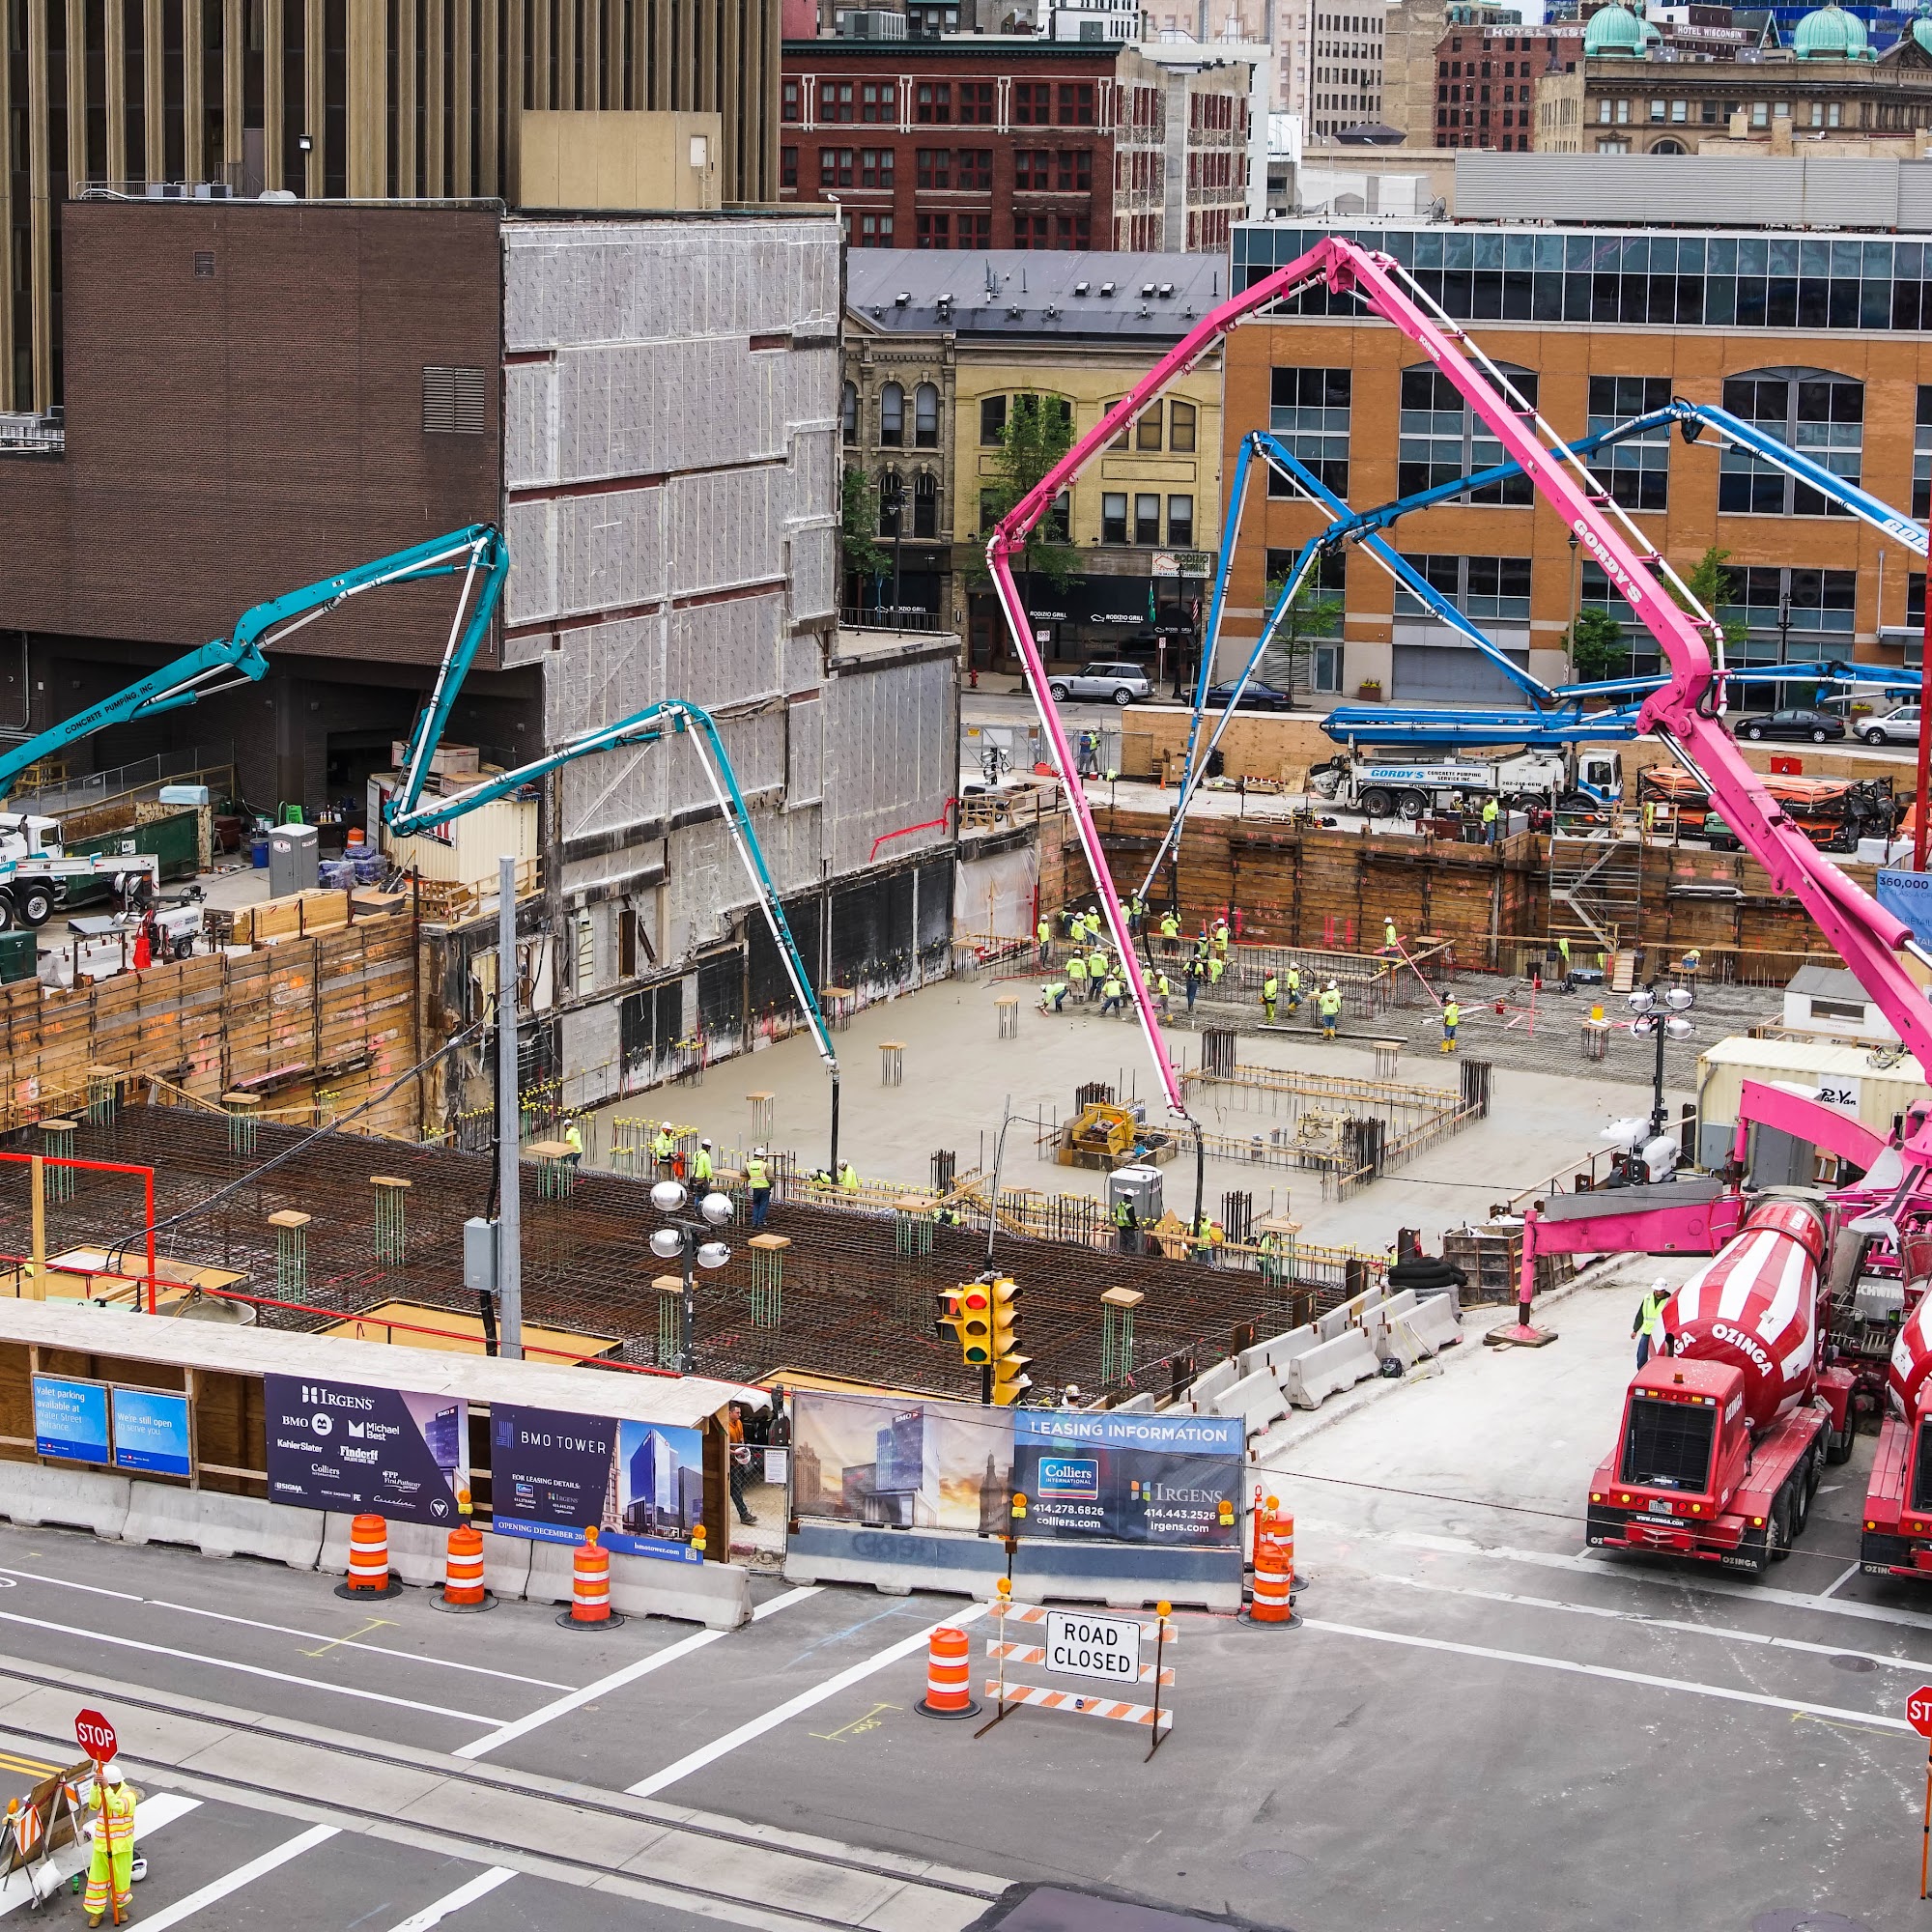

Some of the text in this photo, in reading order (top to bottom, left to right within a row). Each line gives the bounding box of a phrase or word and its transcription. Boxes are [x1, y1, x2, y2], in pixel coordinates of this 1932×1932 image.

[1492, 27, 1586, 38] HOTEL WISC
[1677, 25, 1743, 39] HOTEL WISCONSIN
[1882, 519, 1929, 551] GOR
[1573, 519, 1642, 605] GORDY'S
[65, 682, 156, 735] CONCRETE PUMPING, INC.
[1371, 769, 1424, 779] GORDY'S
[1879, 877, 1929, 890] 360,000
[1821, 1088, 1857, 1105] Pac-Van
[1673, 1331, 1697, 1358] GA
[1712, 1323, 1774, 1378] OZINGA
[36, 1385, 85, 1403] Valet parking
[320, 1388, 373, 1410] IRGENS
[37, 1400, 70, 1411] available
[37, 1409, 82, 1424] Water Street
[117, 1412, 173, 1429] We're still open
[282, 1415, 309, 1428] BMO
[895, 1411, 912, 1423] BMO
[127, 1424, 146, 1434] serve
[366, 1422, 400, 1435] Michael
[366, 1431, 386, 1441] Best
[1030, 1421, 1228, 1442] LEASING INFORMATION
[521, 1431, 607, 1455] BMO TOWER
[311, 1463, 340, 1475] Colliers
[1045, 1464, 1093, 1479] Colliers
[512, 1473, 582, 1490] FOR LEASING DETAILS:
[1154, 1483, 1223, 1504] IRGENS
[1033, 1503, 1104, 1517] 414.278.6826
[1143, 1508, 1216, 1520] 414.443.2526
[497, 1521, 532, 1533] OPENING
[533, 1527, 574, 1539] DECEMBER
[1037, 1517, 1101, 1529] colliers.com
[1151, 1521, 1209, 1534] irgens.com
[634, 1542, 680, 1556] bmotower.com
[1721, 1555, 1758, 1569] OZINGA
[1864, 1564, 1894, 1576] OZIN
[1064, 1622, 1119, 1646] ROAD
[1054, 1646, 1130, 1673] CLOSED
[1909, 1699, 1932, 1722] ST
[77, 1721, 114, 1748] STOP
